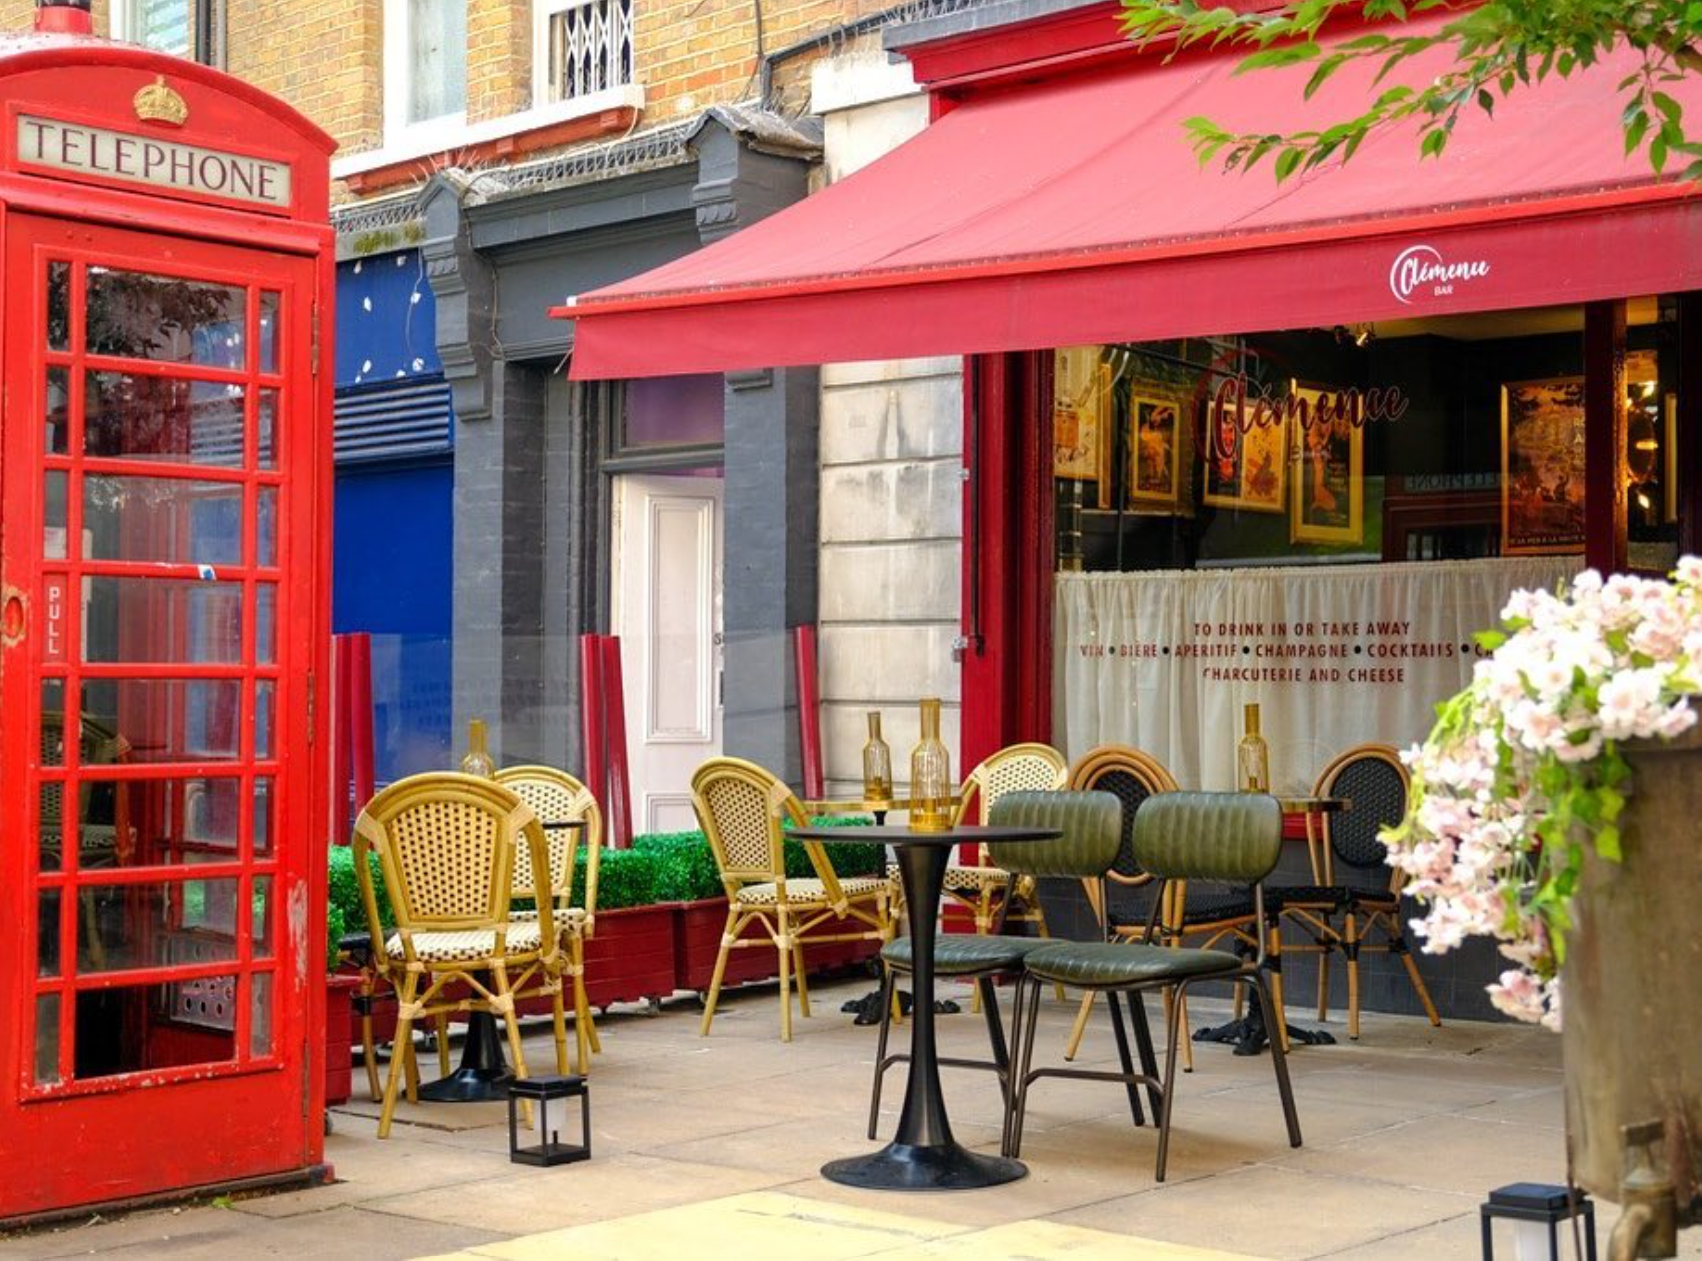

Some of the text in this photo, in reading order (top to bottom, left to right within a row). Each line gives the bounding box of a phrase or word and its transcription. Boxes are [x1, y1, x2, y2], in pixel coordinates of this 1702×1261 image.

[26, 120, 277, 200] TELEPHONE
[1434, 284, 1454, 297] BAR
[48, 585, 61, 655] PULL
[1194, 621, 1410, 637] TO DRINK IN OR TAKE AWAY
[1080, 644, 1104, 658] VIN
[1175, 643, 1238, 658] APERITIF
[1255, 643, 1349, 658] CHAMPAGNE
[1202, 667, 1405, 682] CHARCUTERIE AND CHEESE
